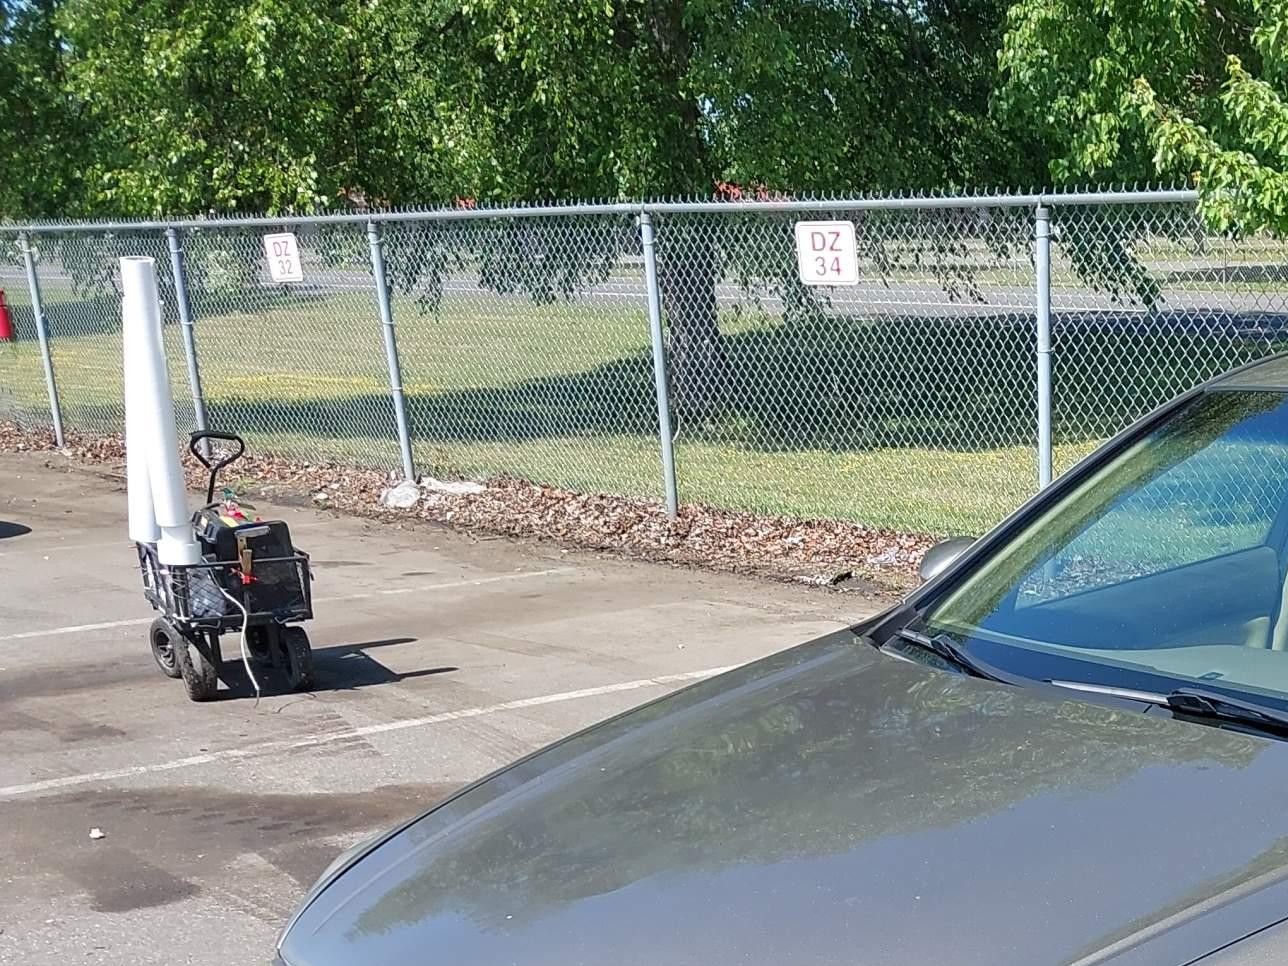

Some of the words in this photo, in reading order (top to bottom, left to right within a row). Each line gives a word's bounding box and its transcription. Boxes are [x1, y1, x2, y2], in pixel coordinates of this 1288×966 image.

[272, 240, 292, 257] DZ
[811, 231, 843, 252] DZ
[278, 259, 294, 275] 32
[815, 256, 842, 276] 34
